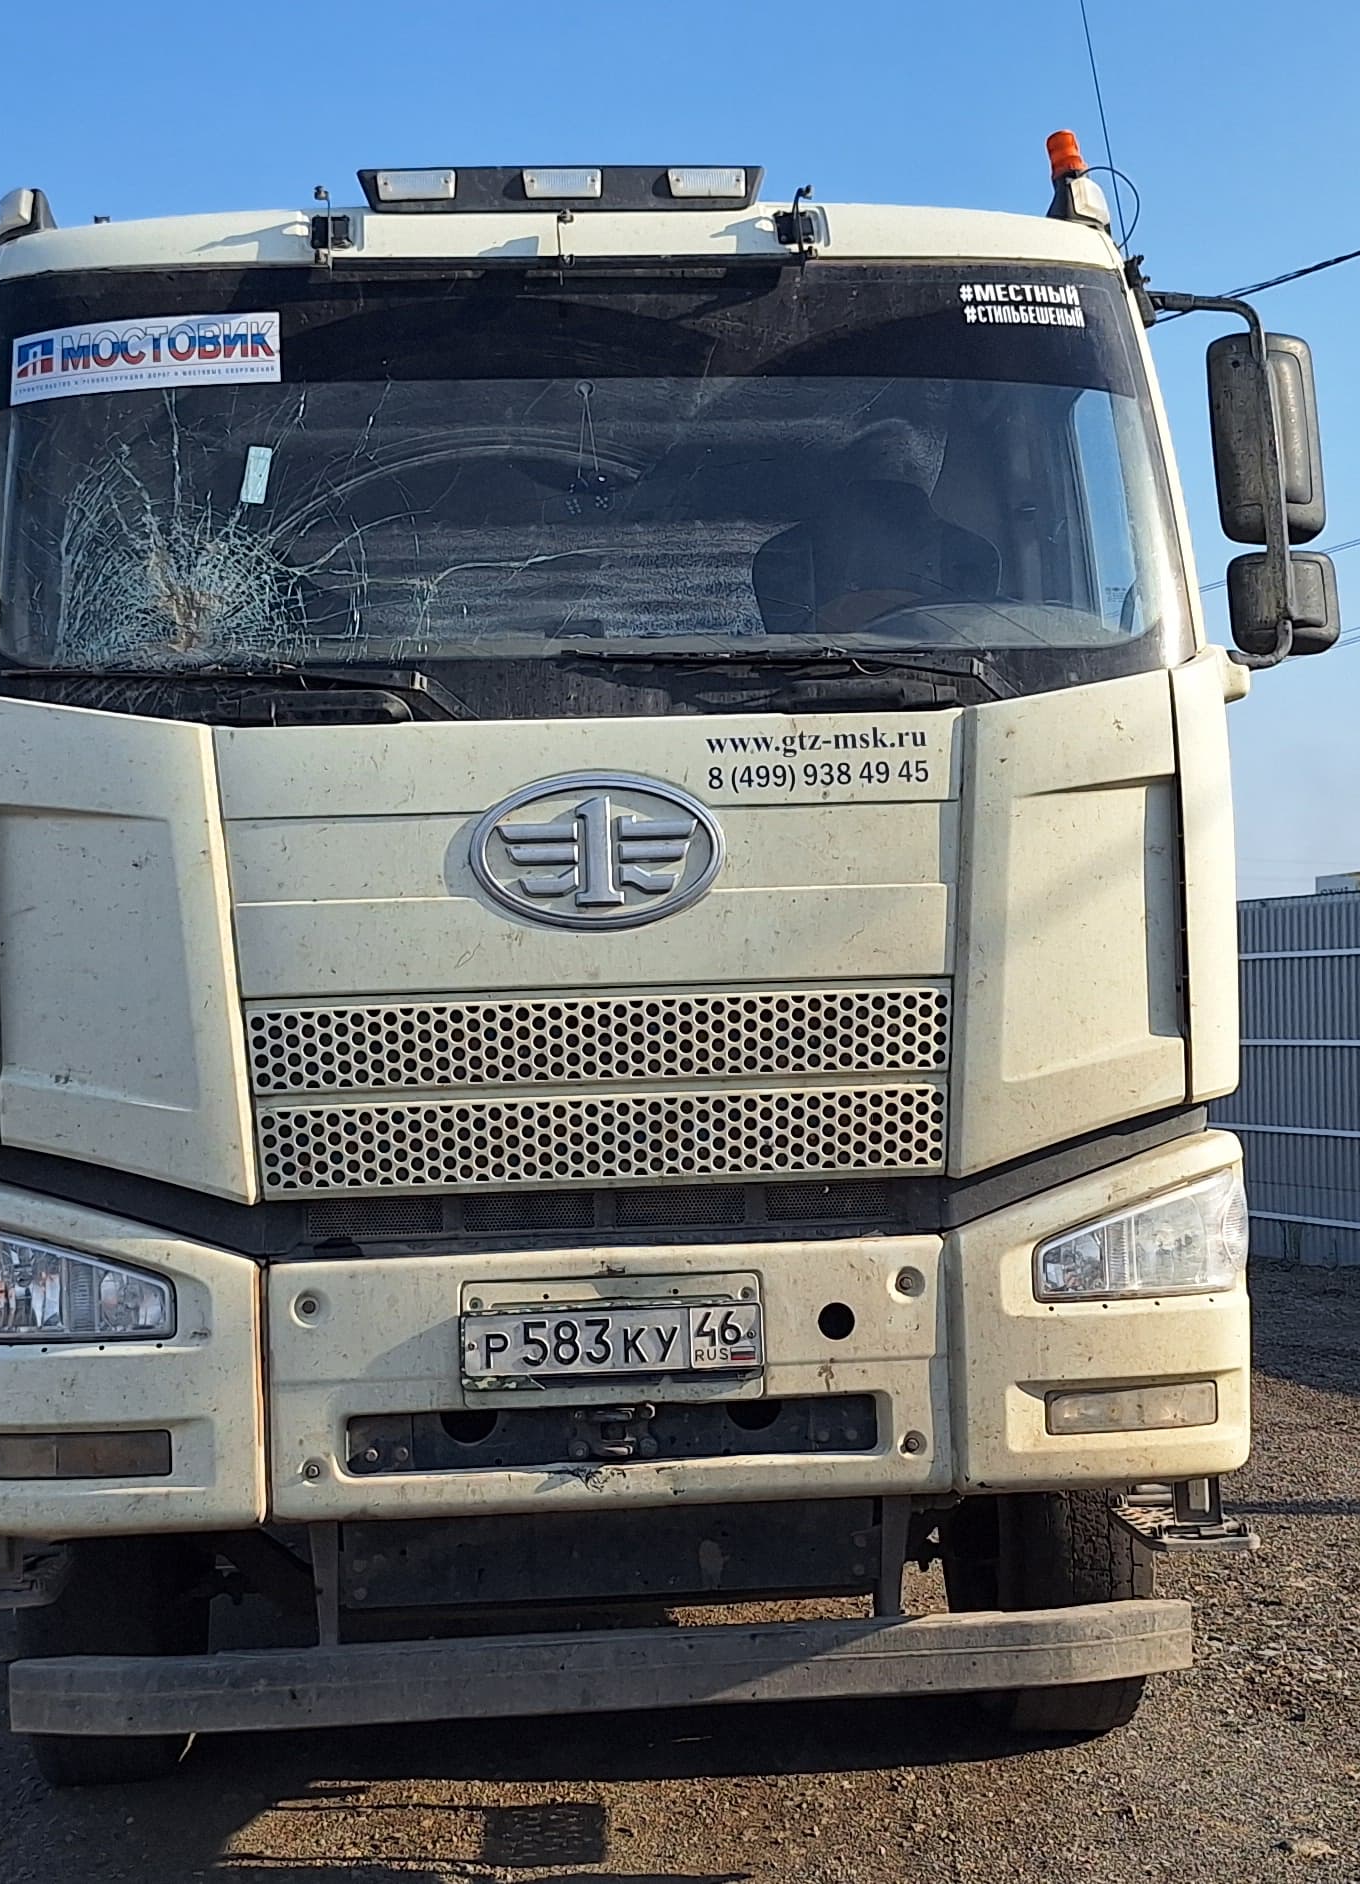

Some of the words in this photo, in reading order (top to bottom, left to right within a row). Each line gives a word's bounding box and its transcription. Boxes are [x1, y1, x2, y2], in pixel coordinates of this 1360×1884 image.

[959, 284, 1080, 306] #МЕСТНЫЙ
[61, 320, 275, 373] МОСТОВИК
[706, 727, 927, 757] www.gtz-msk.ru
[708, 767, 723, 789] 8
[731, 764, 796, 793] (499)
[803, 762, 852, 786] 938
[859, 761, 890, 784] 49
[898, 759, 929, 782] 45
[697, 1310, 740, 1346] 46
[694, 1348, 729, 1361] RUS
